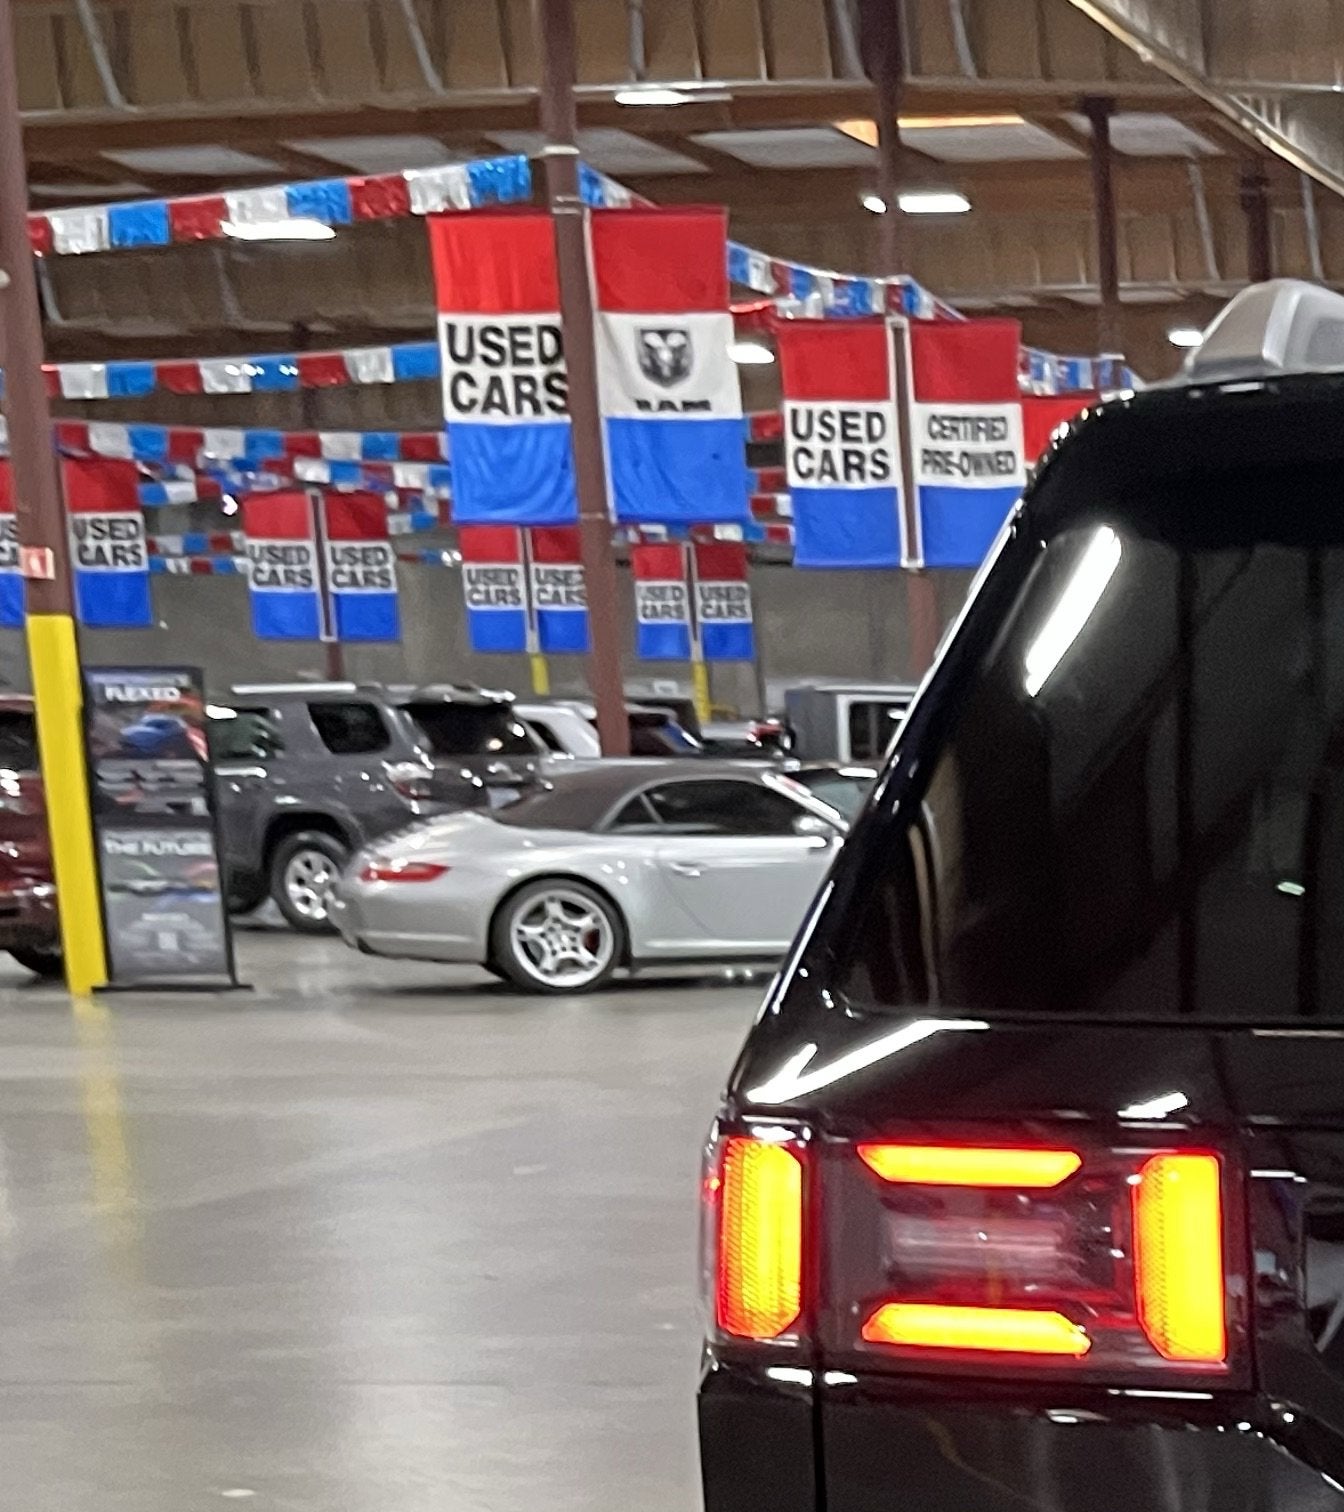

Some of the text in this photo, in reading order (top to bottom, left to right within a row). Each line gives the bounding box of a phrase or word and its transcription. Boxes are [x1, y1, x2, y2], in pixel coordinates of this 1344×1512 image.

[446, 322, 564, 367] USED
[450, 370, 568, 416] CARS
[790, 408, 887, 444] USED
[927, 413, 1008, 442] CERTIFIED
[792, 446, 891, 483] CARS
[921, 448, 1017, 477] PRE-OWNED
[72, 517, 140, 541] USED
[77, 543, 143, 567] CARS
[249, 544, 311, 566] USED
[331, 545, 389, 567] USED
[252, 566, 313, 588] CARS
[331, 567, 392, 589] CARS
[466, 567, 519, 586] USED
[467, 587, 521, 606] CARS
